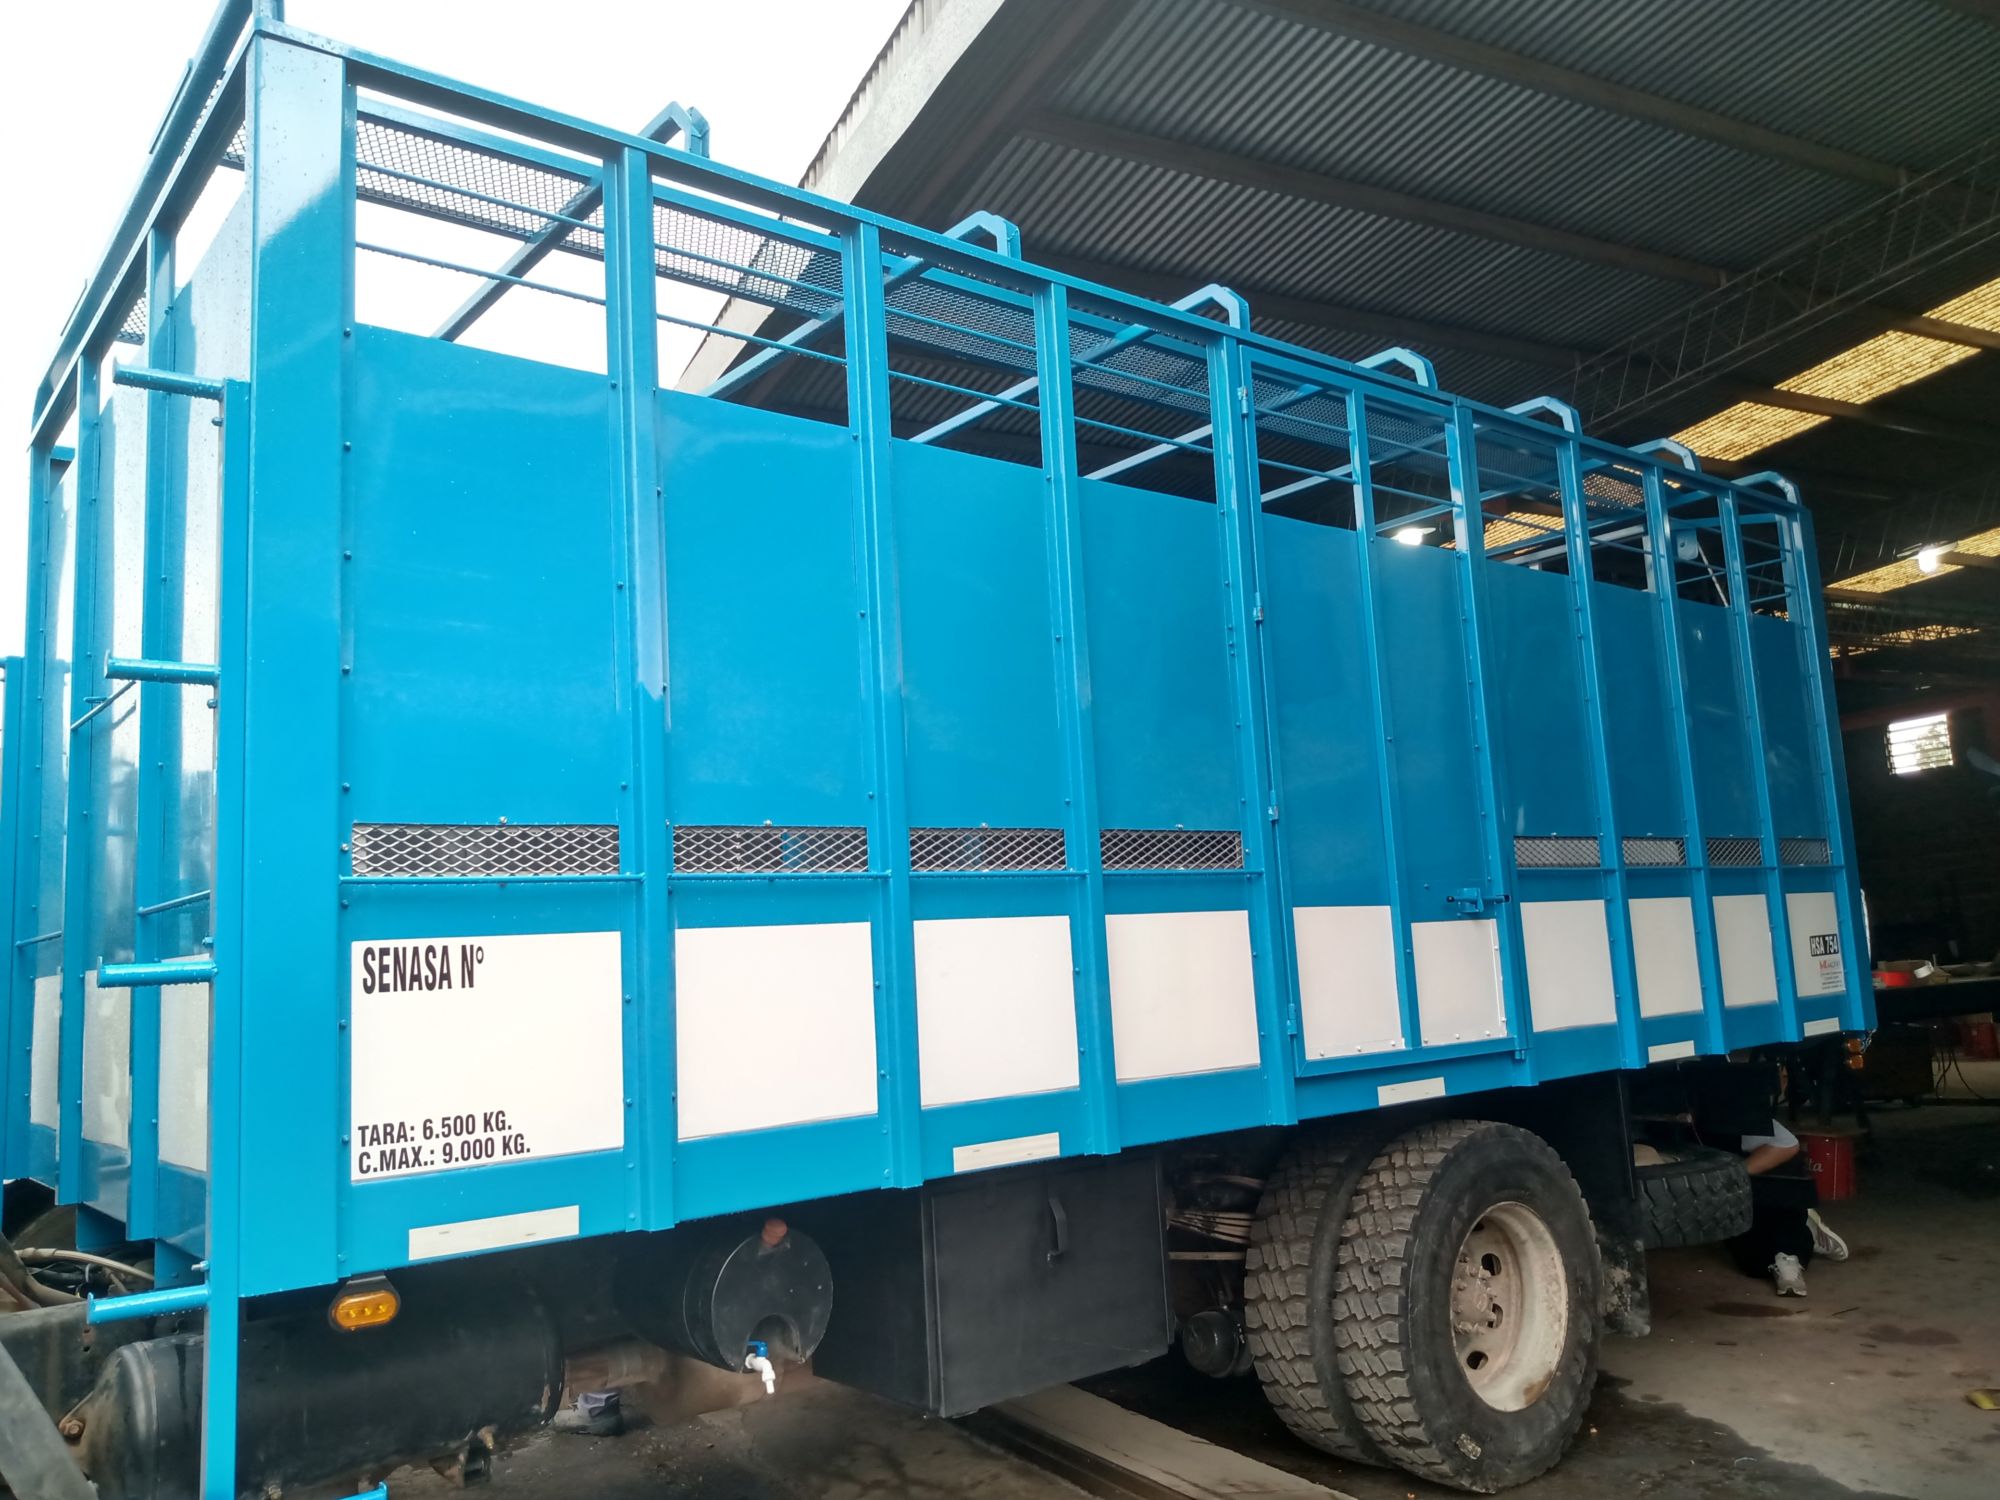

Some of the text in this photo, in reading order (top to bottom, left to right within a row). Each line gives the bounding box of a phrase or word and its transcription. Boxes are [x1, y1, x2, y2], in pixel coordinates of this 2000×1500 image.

[362, 944, 452, 995] SENASA
[357, 1110, 512, 1148] TARA: 6.500 KG.
[358, 1133, 531, 1174] C.MAX.: 9.000 KG.
